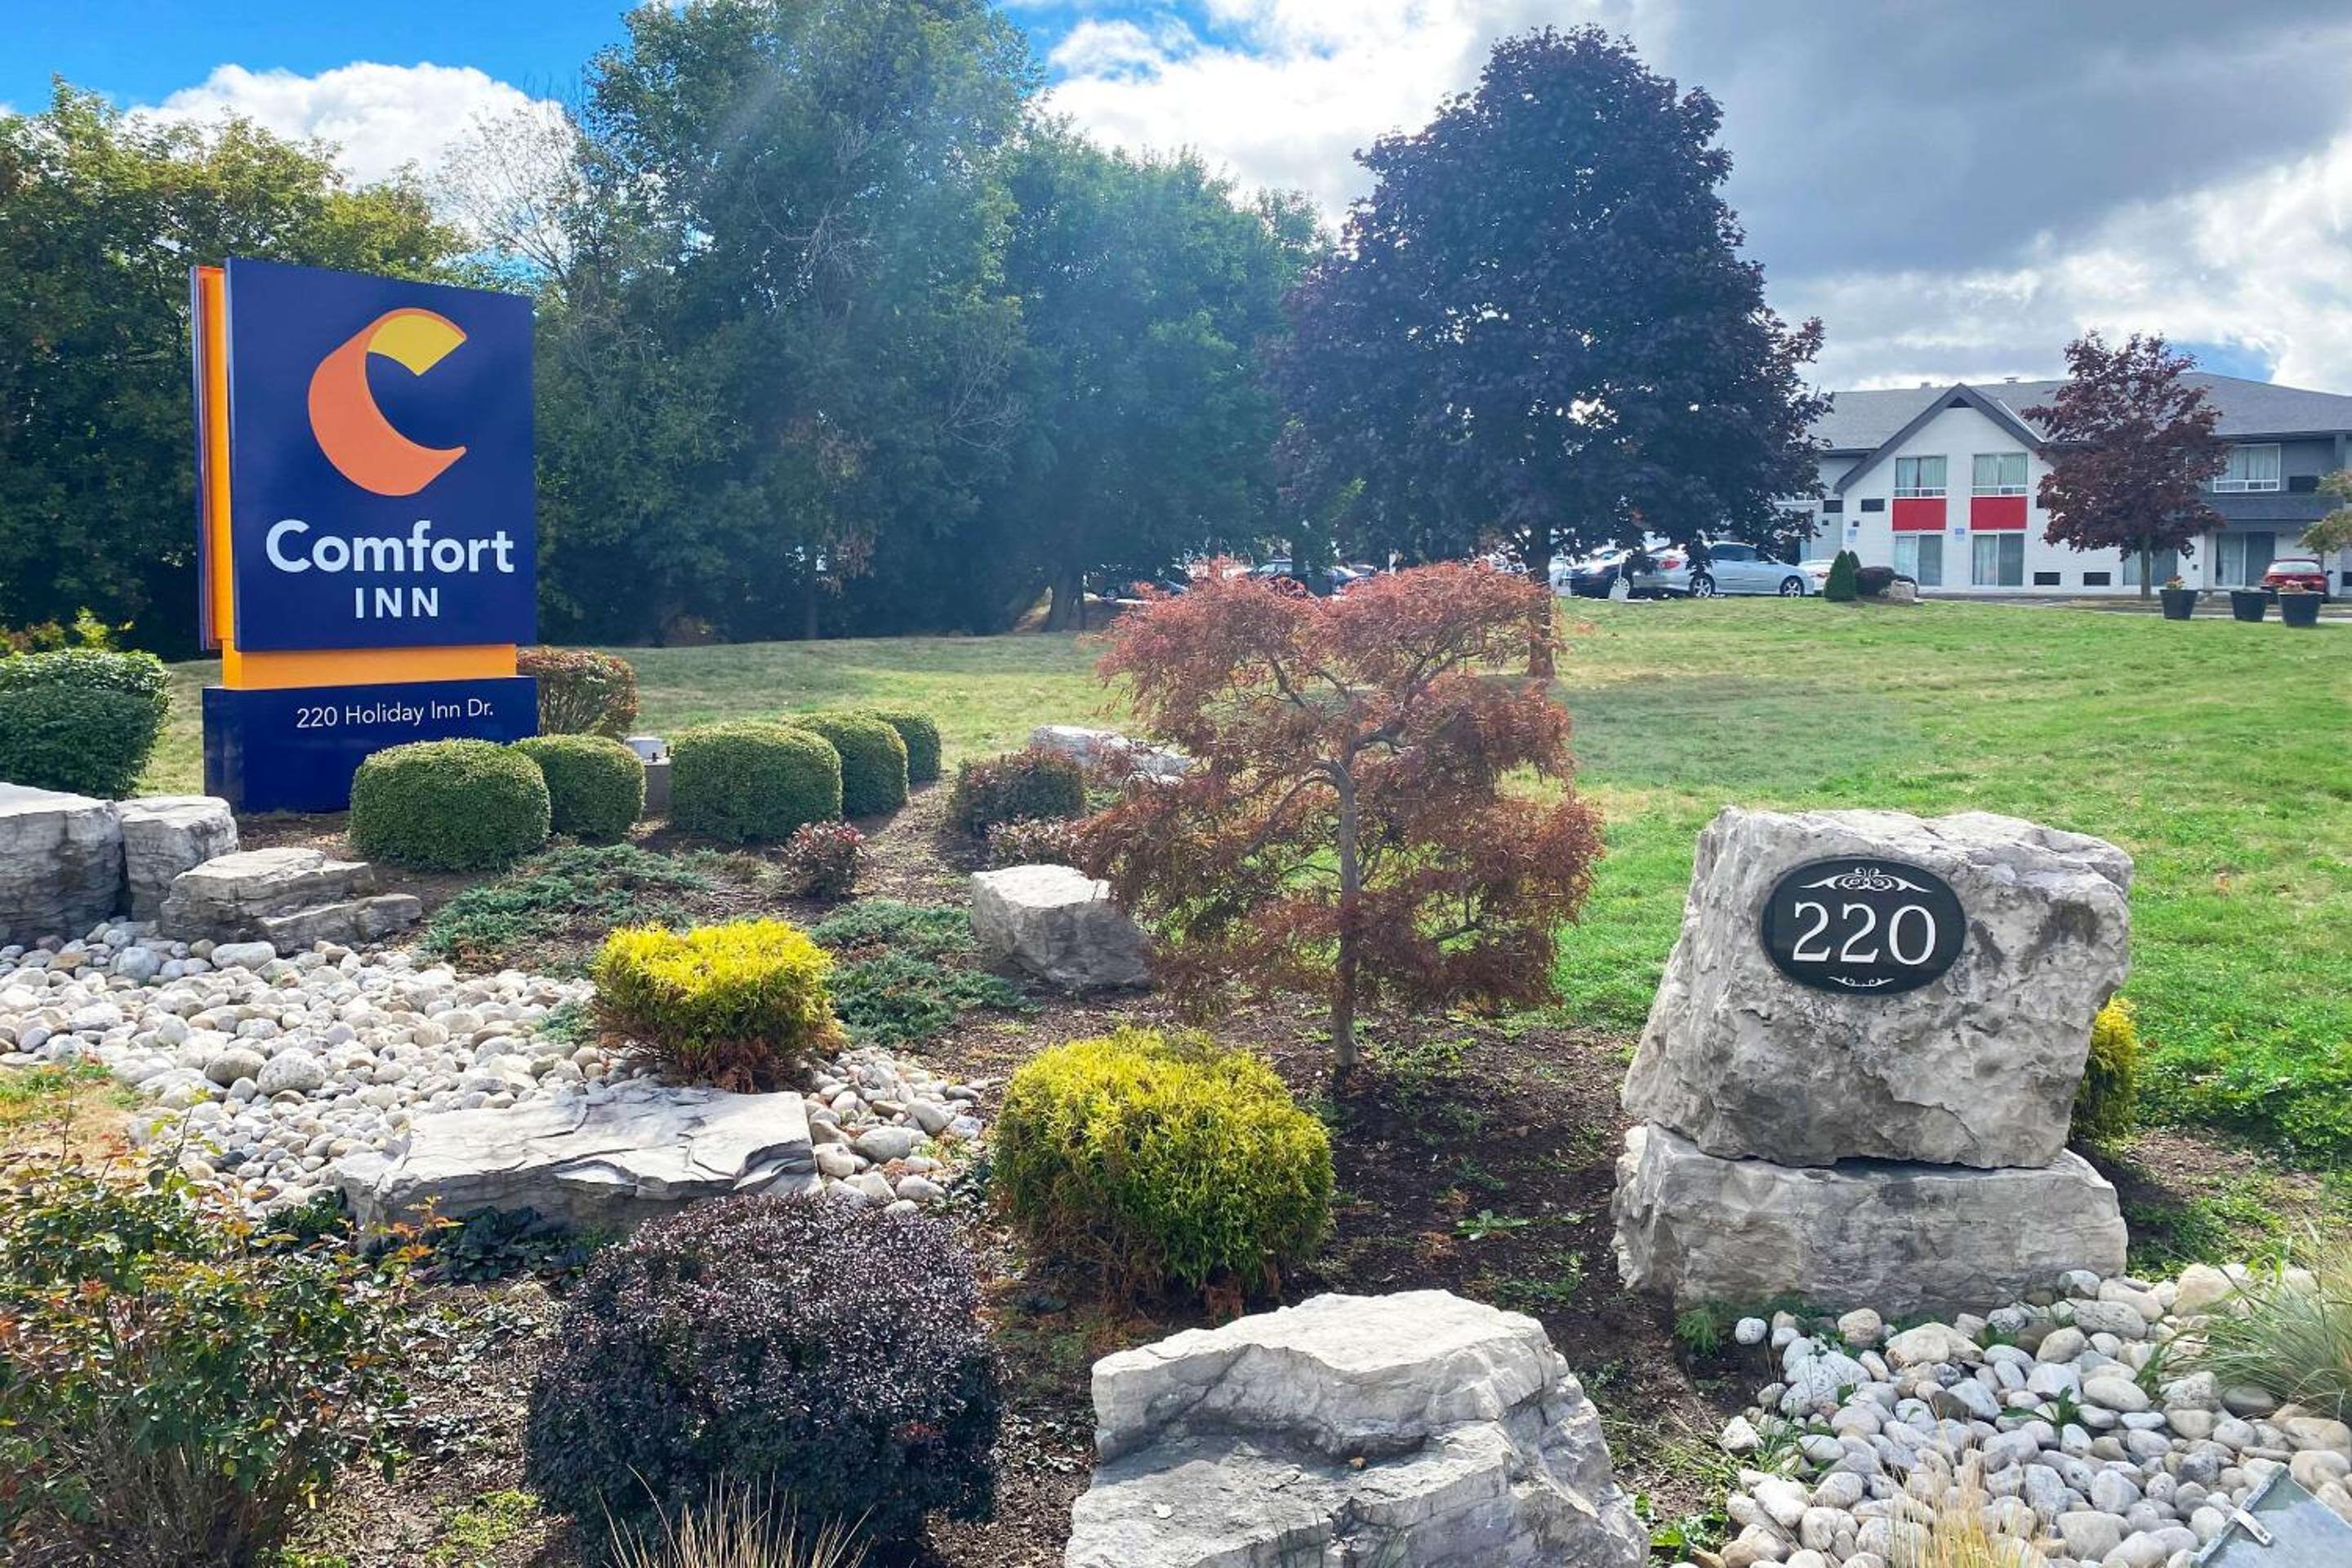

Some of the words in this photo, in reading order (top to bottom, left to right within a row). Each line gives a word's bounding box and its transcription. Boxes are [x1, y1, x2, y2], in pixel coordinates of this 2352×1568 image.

[266, 519, 514, 572] Comfort
[355, 587, 438, 618] INN
[296, 706, 338, 728] 220
[345, 702, 424, 726] Holiday
[431, 700, 461, 719] Inn
[468, 698, 493, 717] Dr.
[1793, 901, 1936, 965] 220
